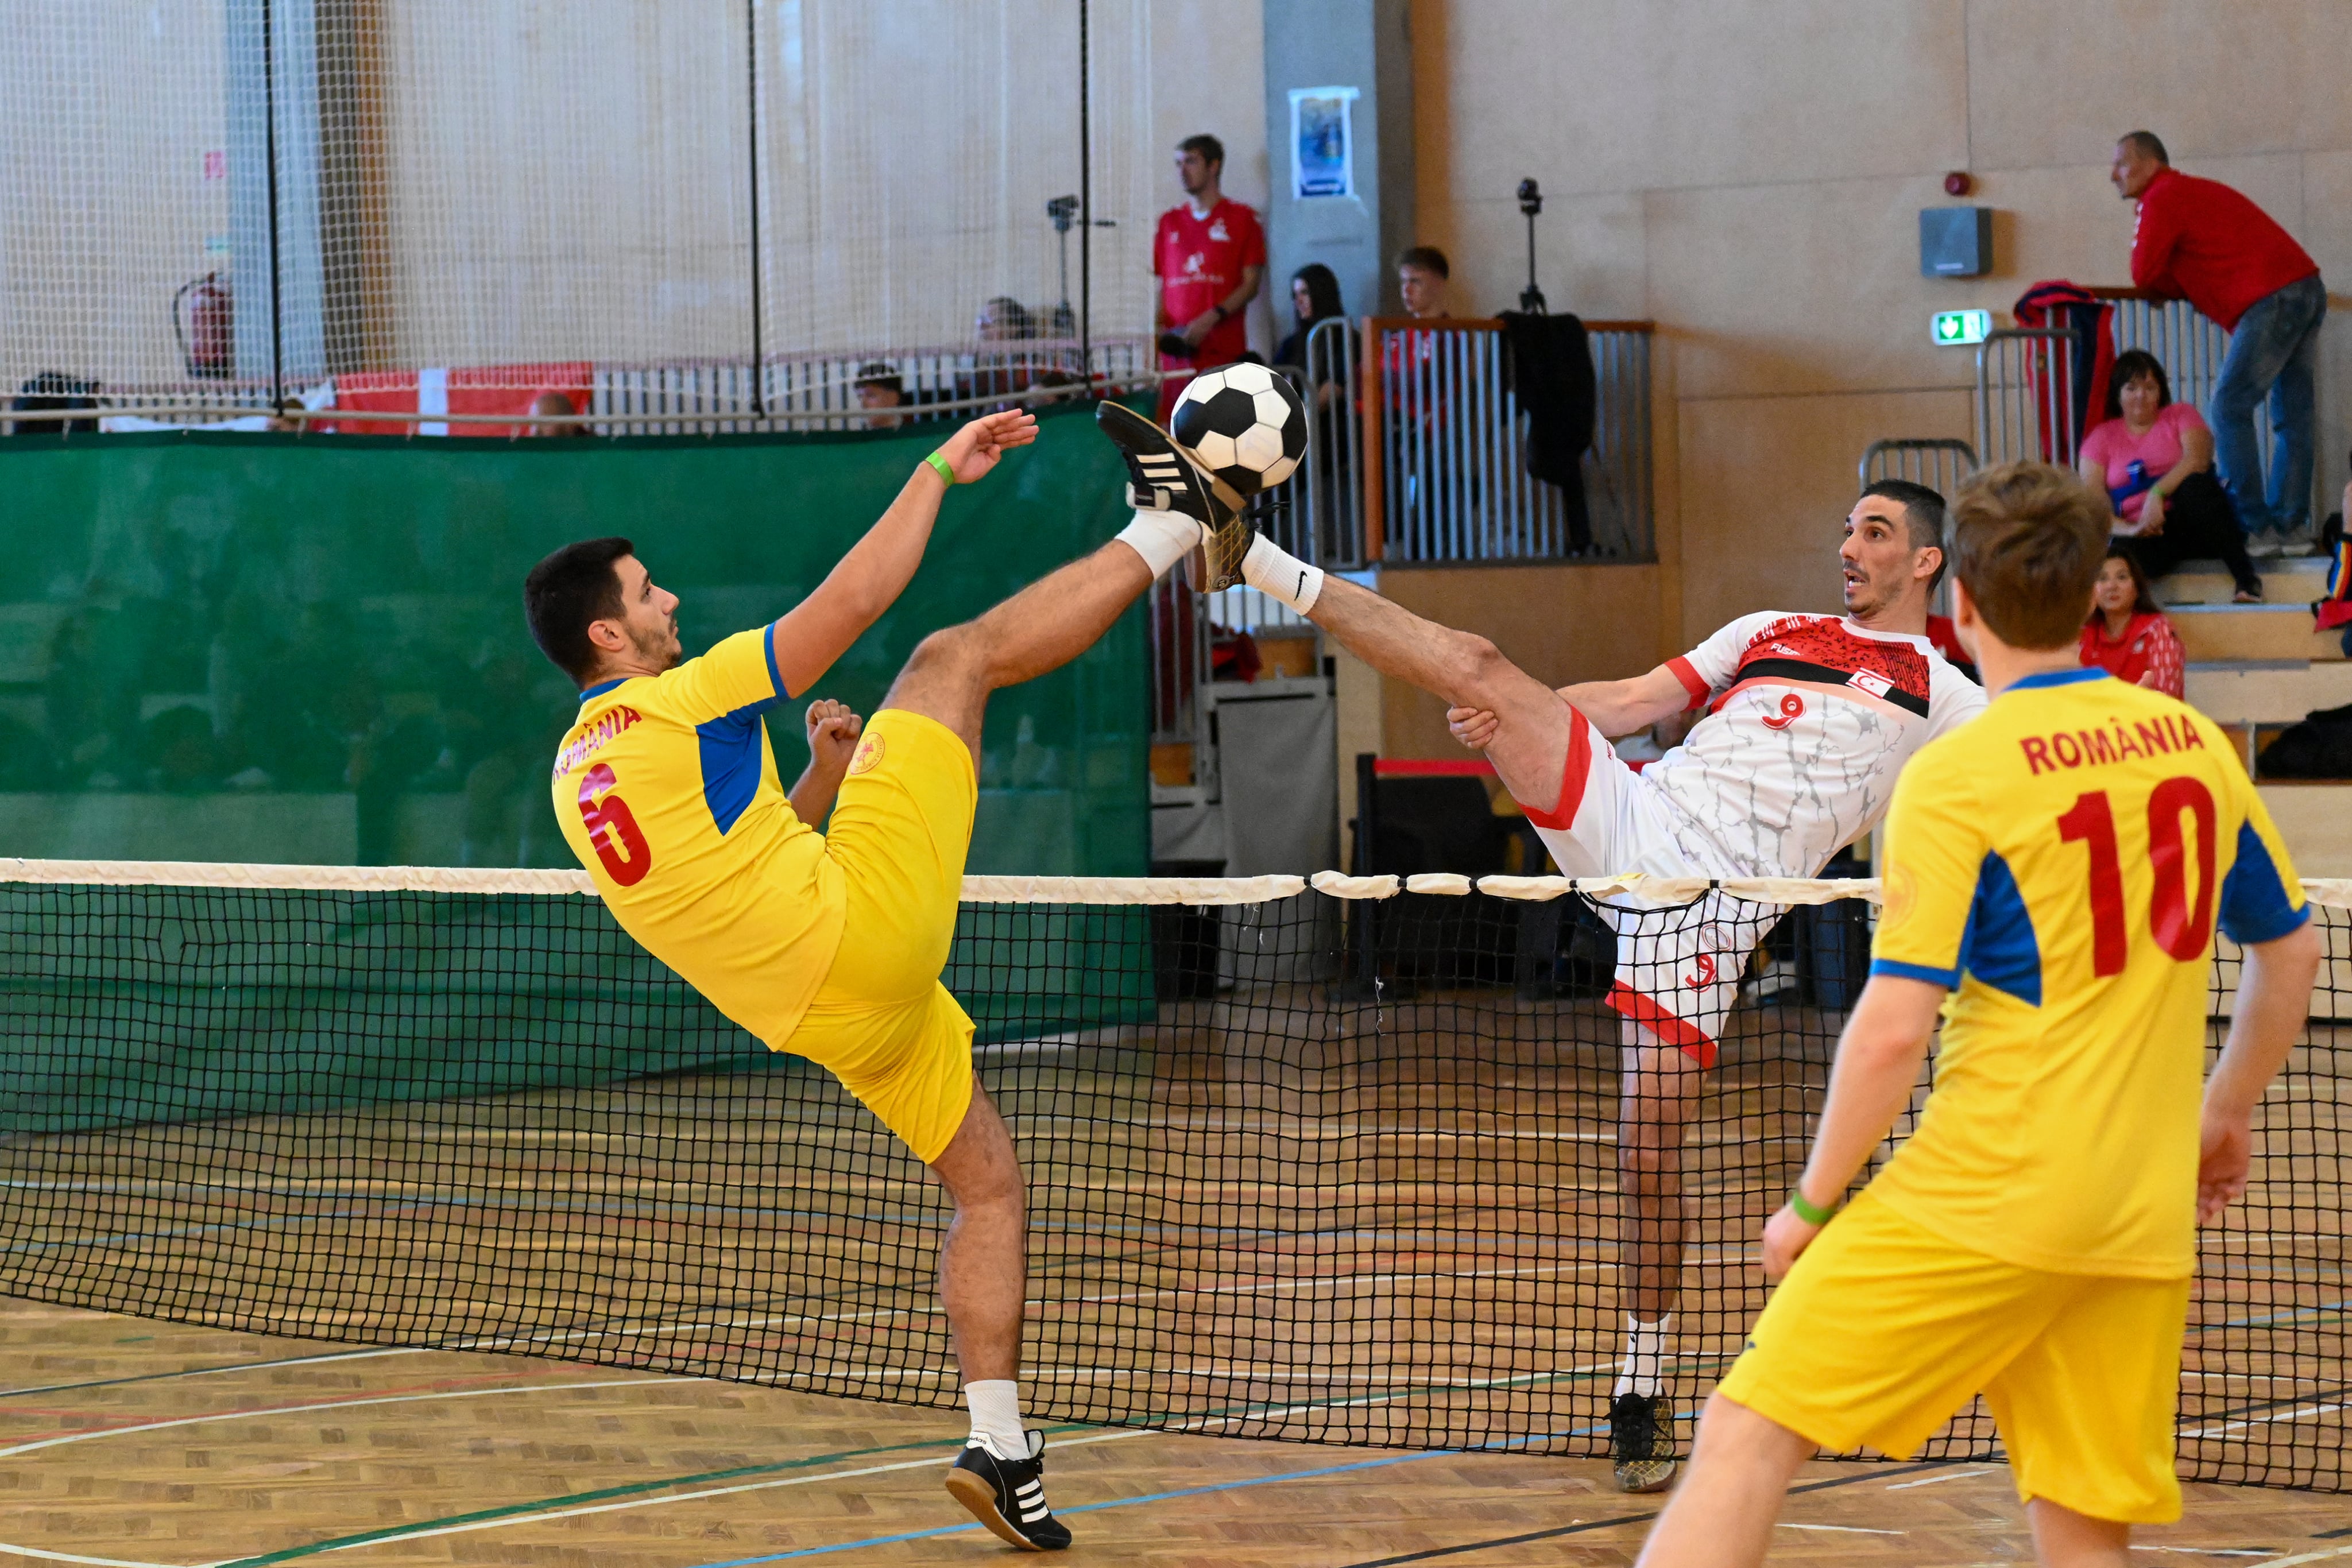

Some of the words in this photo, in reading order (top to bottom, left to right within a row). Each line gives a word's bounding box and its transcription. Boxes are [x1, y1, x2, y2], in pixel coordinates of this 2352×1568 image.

[1761, 693, 1806, 730] 9
[2019, 713, 2205, 776] ROMÂNIA
[578, 763, 652, 887] 6
[2057, 776, 2217, 978] 10
[1685, 954, 1716, 993] 9
